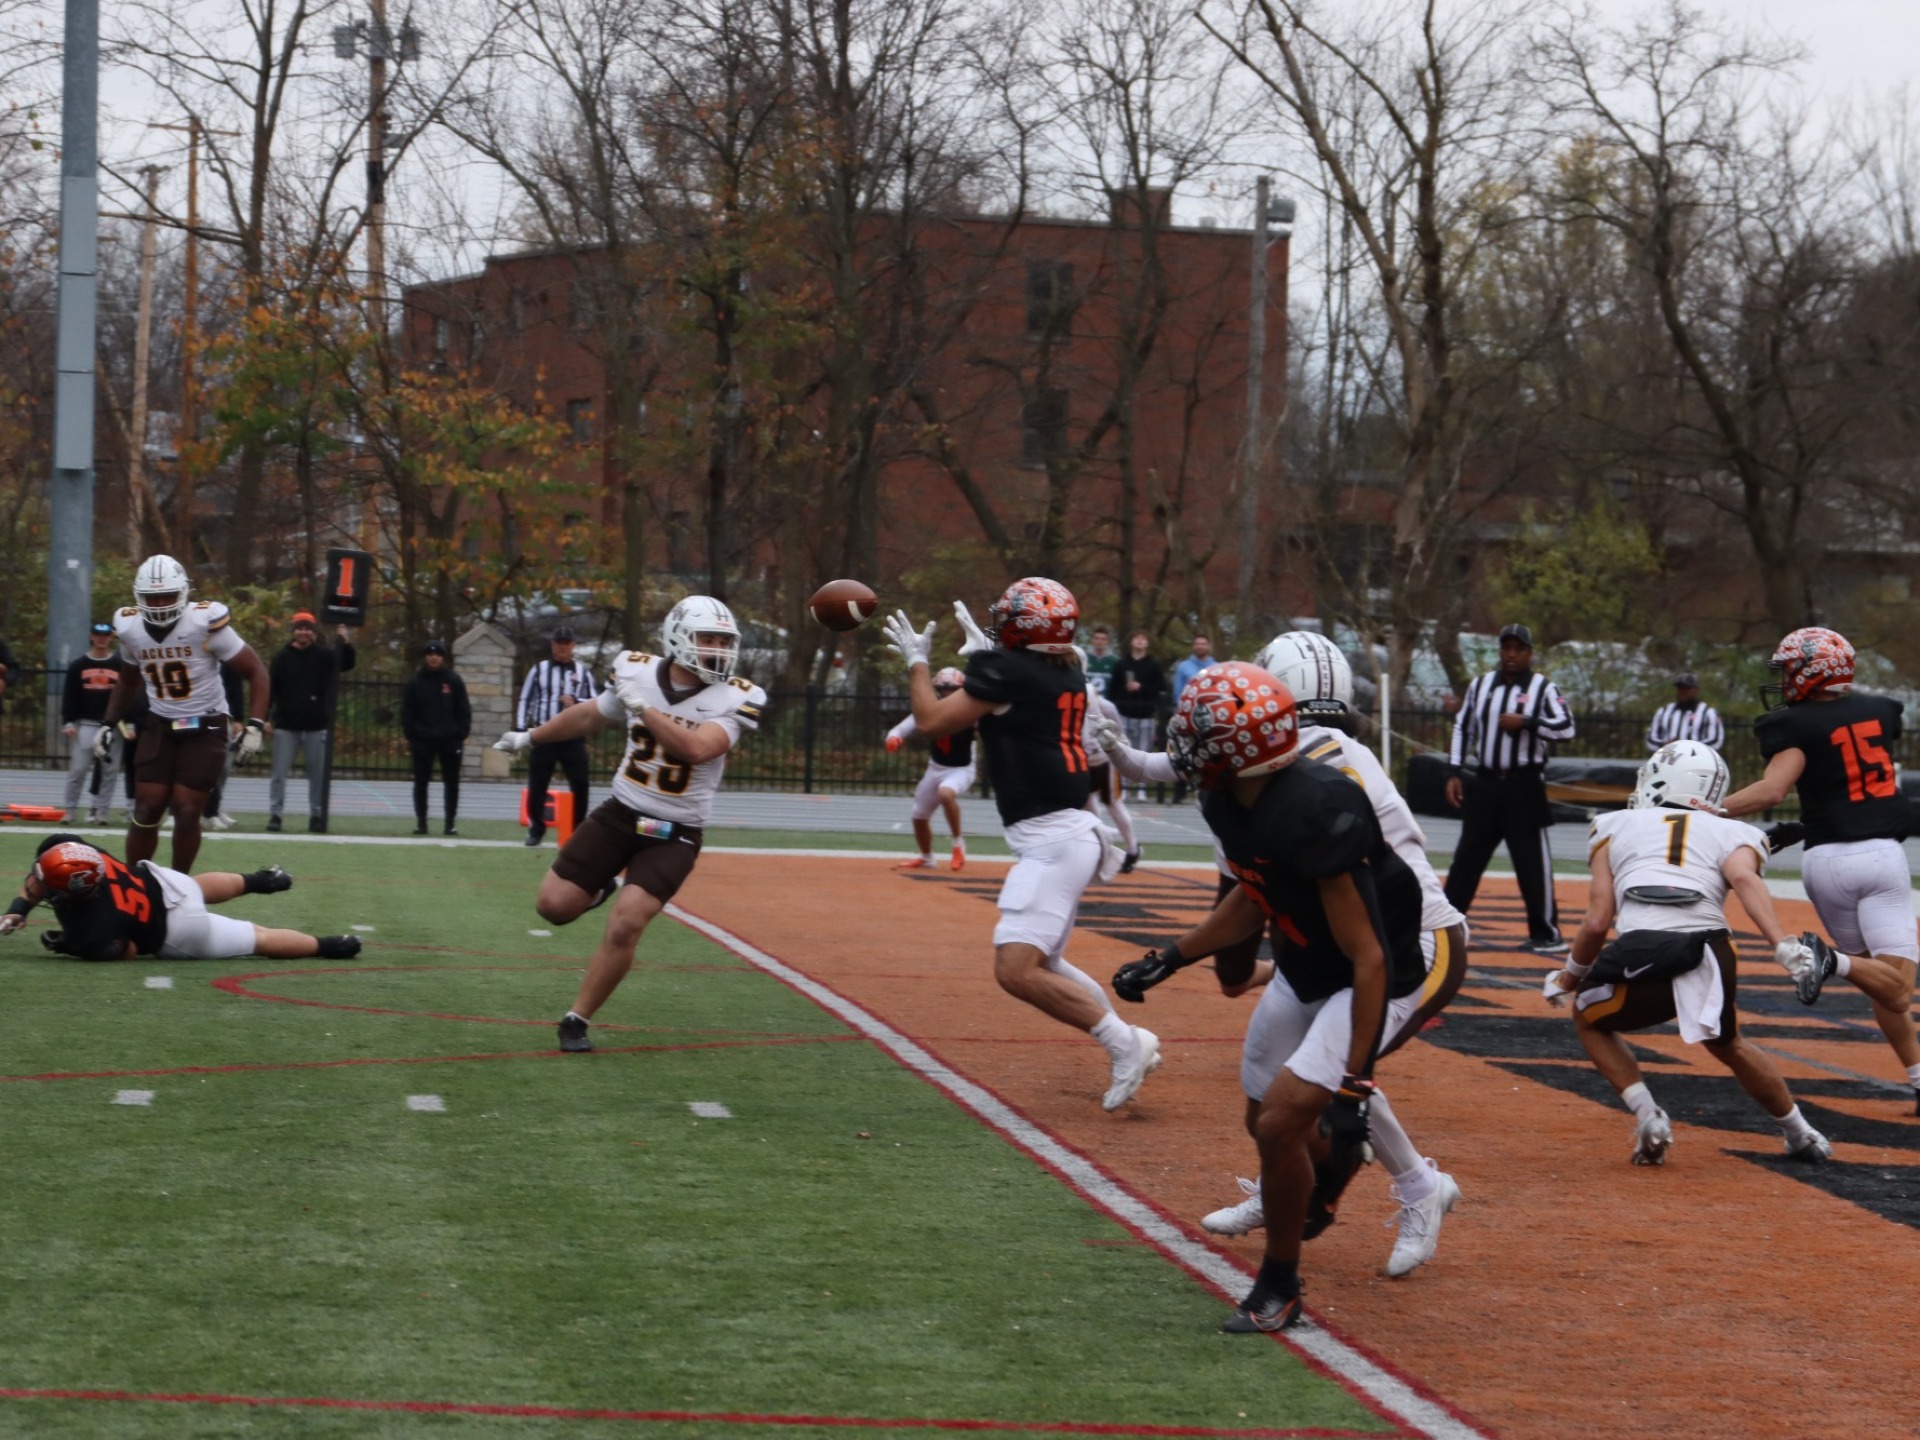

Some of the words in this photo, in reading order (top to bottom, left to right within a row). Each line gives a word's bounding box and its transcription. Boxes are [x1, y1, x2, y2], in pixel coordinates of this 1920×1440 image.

[336, 557, 354, 597] 1
[144, 660, 193, 702] 19
[1056, 691, 1089, 773] 11
[1830, 719, 1896, 802] 15
[1662, 812, 1692, 869] 1
[100, 852, 151, 923] 57
